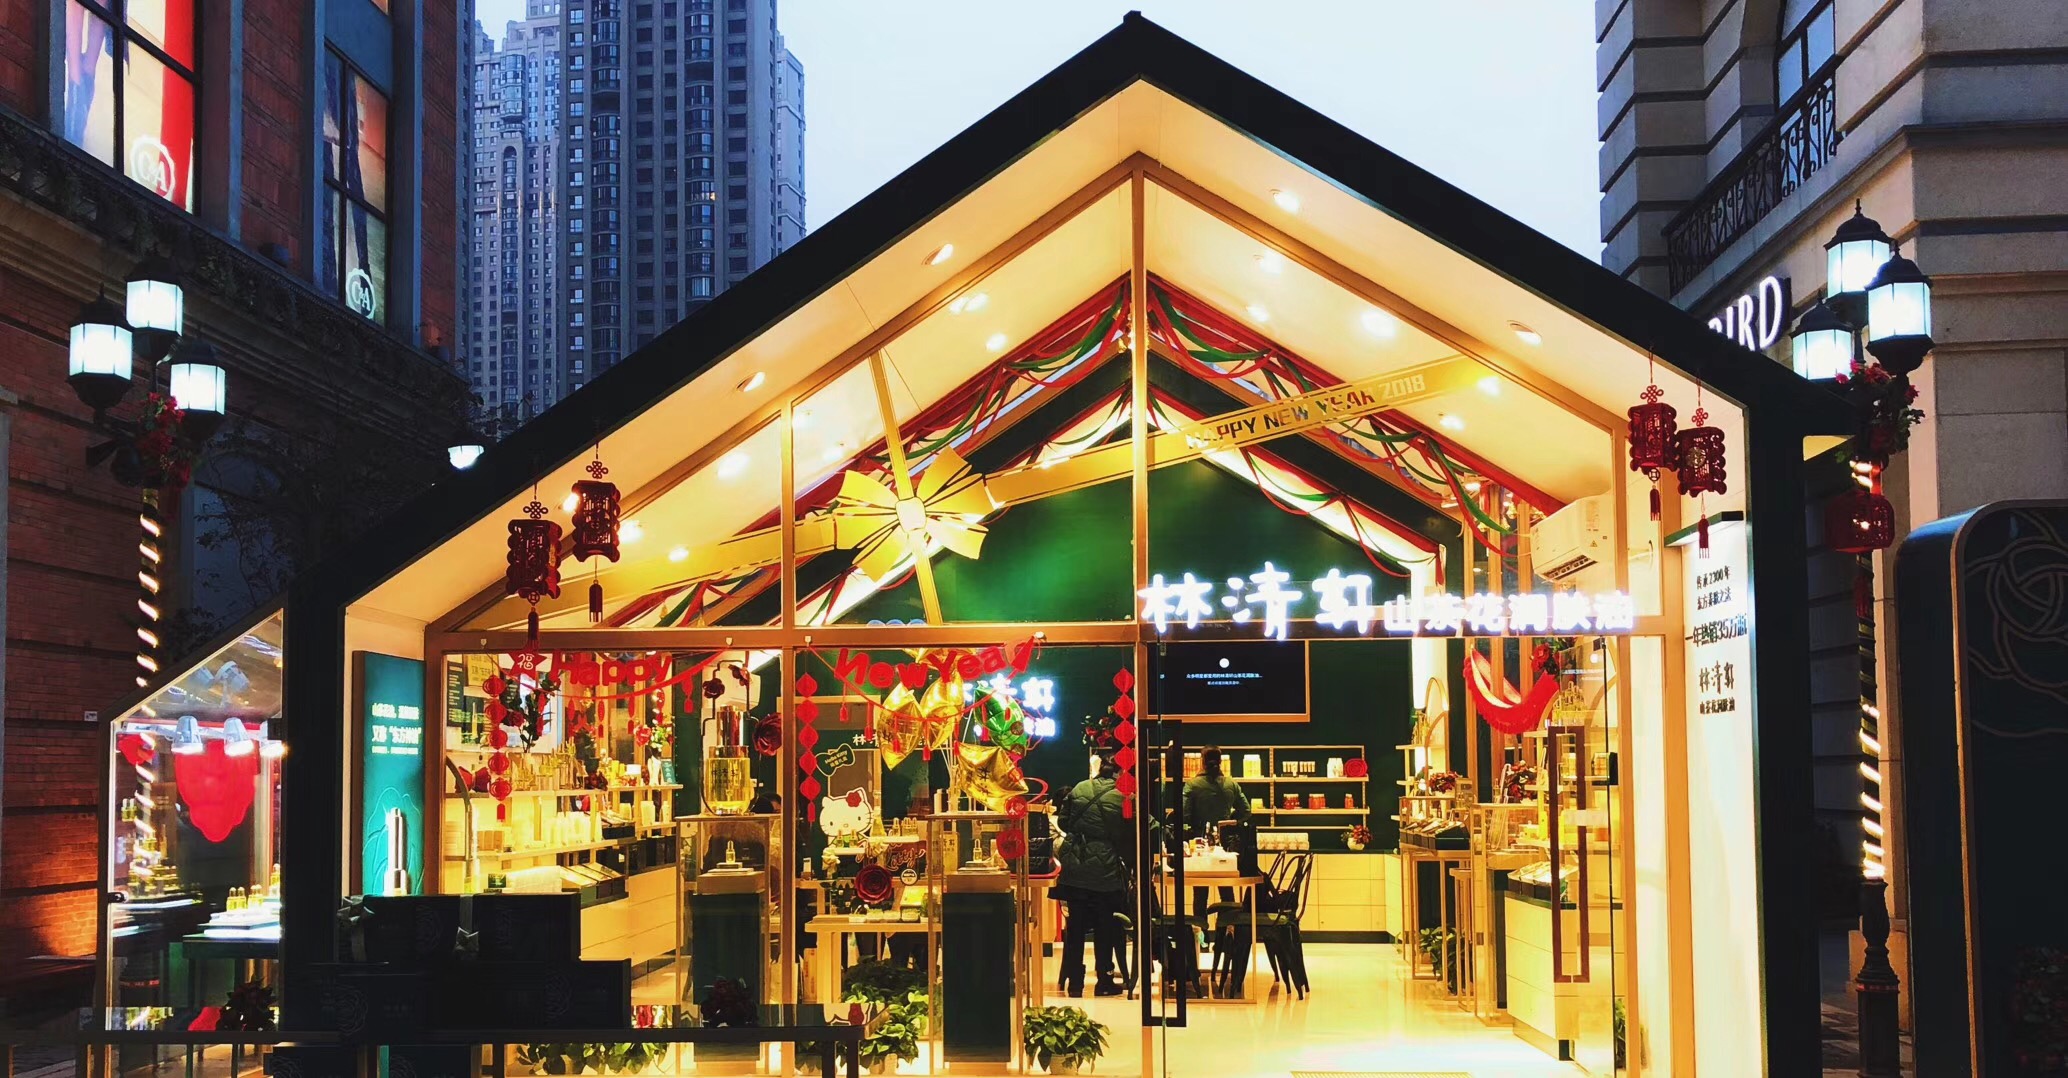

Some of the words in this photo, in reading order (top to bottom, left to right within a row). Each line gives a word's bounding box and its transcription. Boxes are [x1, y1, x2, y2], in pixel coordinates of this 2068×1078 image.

[1264, 404, 1310, 431] NEW
[1380, 373, 1427, 400] 2018
[1139, 561, 1376, 641] 林清轩
[549, 649, 672, 687] Happy
[1699, 660, 1735, 694] 林清轩
